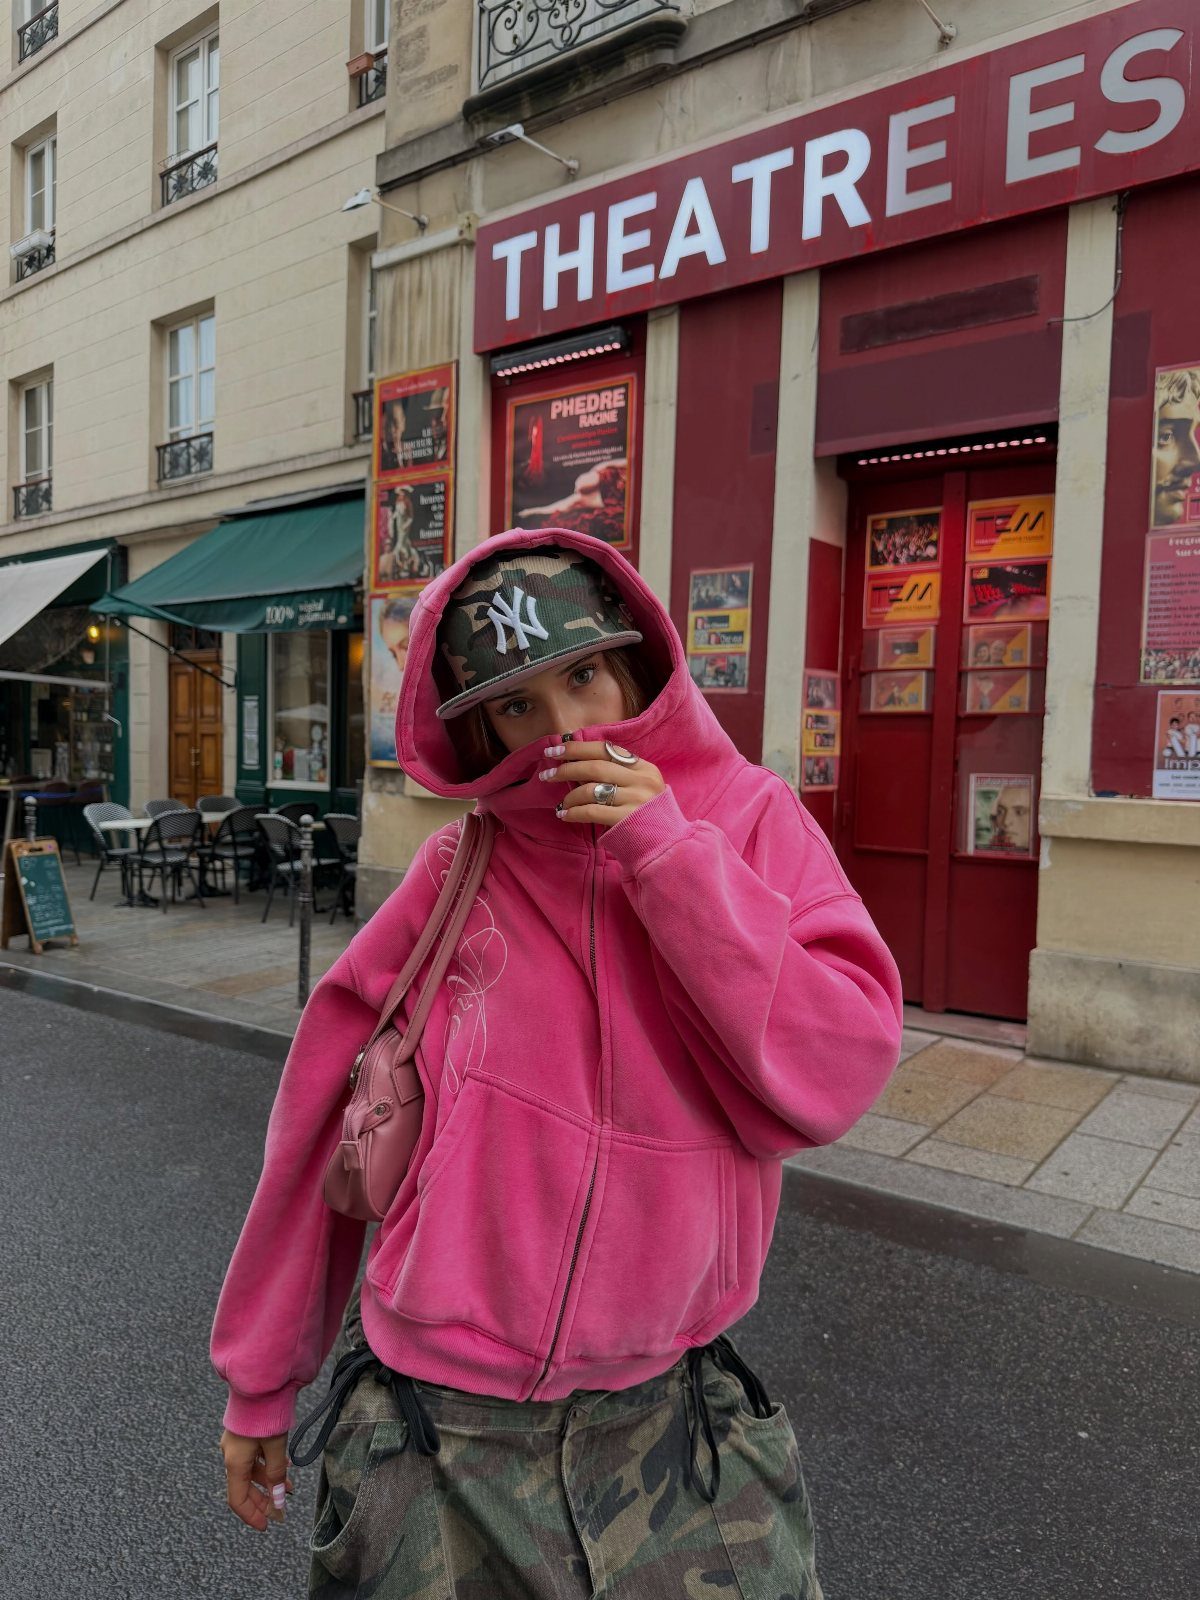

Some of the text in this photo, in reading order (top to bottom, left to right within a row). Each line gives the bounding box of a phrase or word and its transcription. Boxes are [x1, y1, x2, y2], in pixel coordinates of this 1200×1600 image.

[492, 95, 955, 322] THEATRE
[550, 387, 626, 419] PHEDRE
[579, 409, 619, 428] RACINE
[265, 606, 295, 625] 100%
[486, 585, 549, 655] NY
